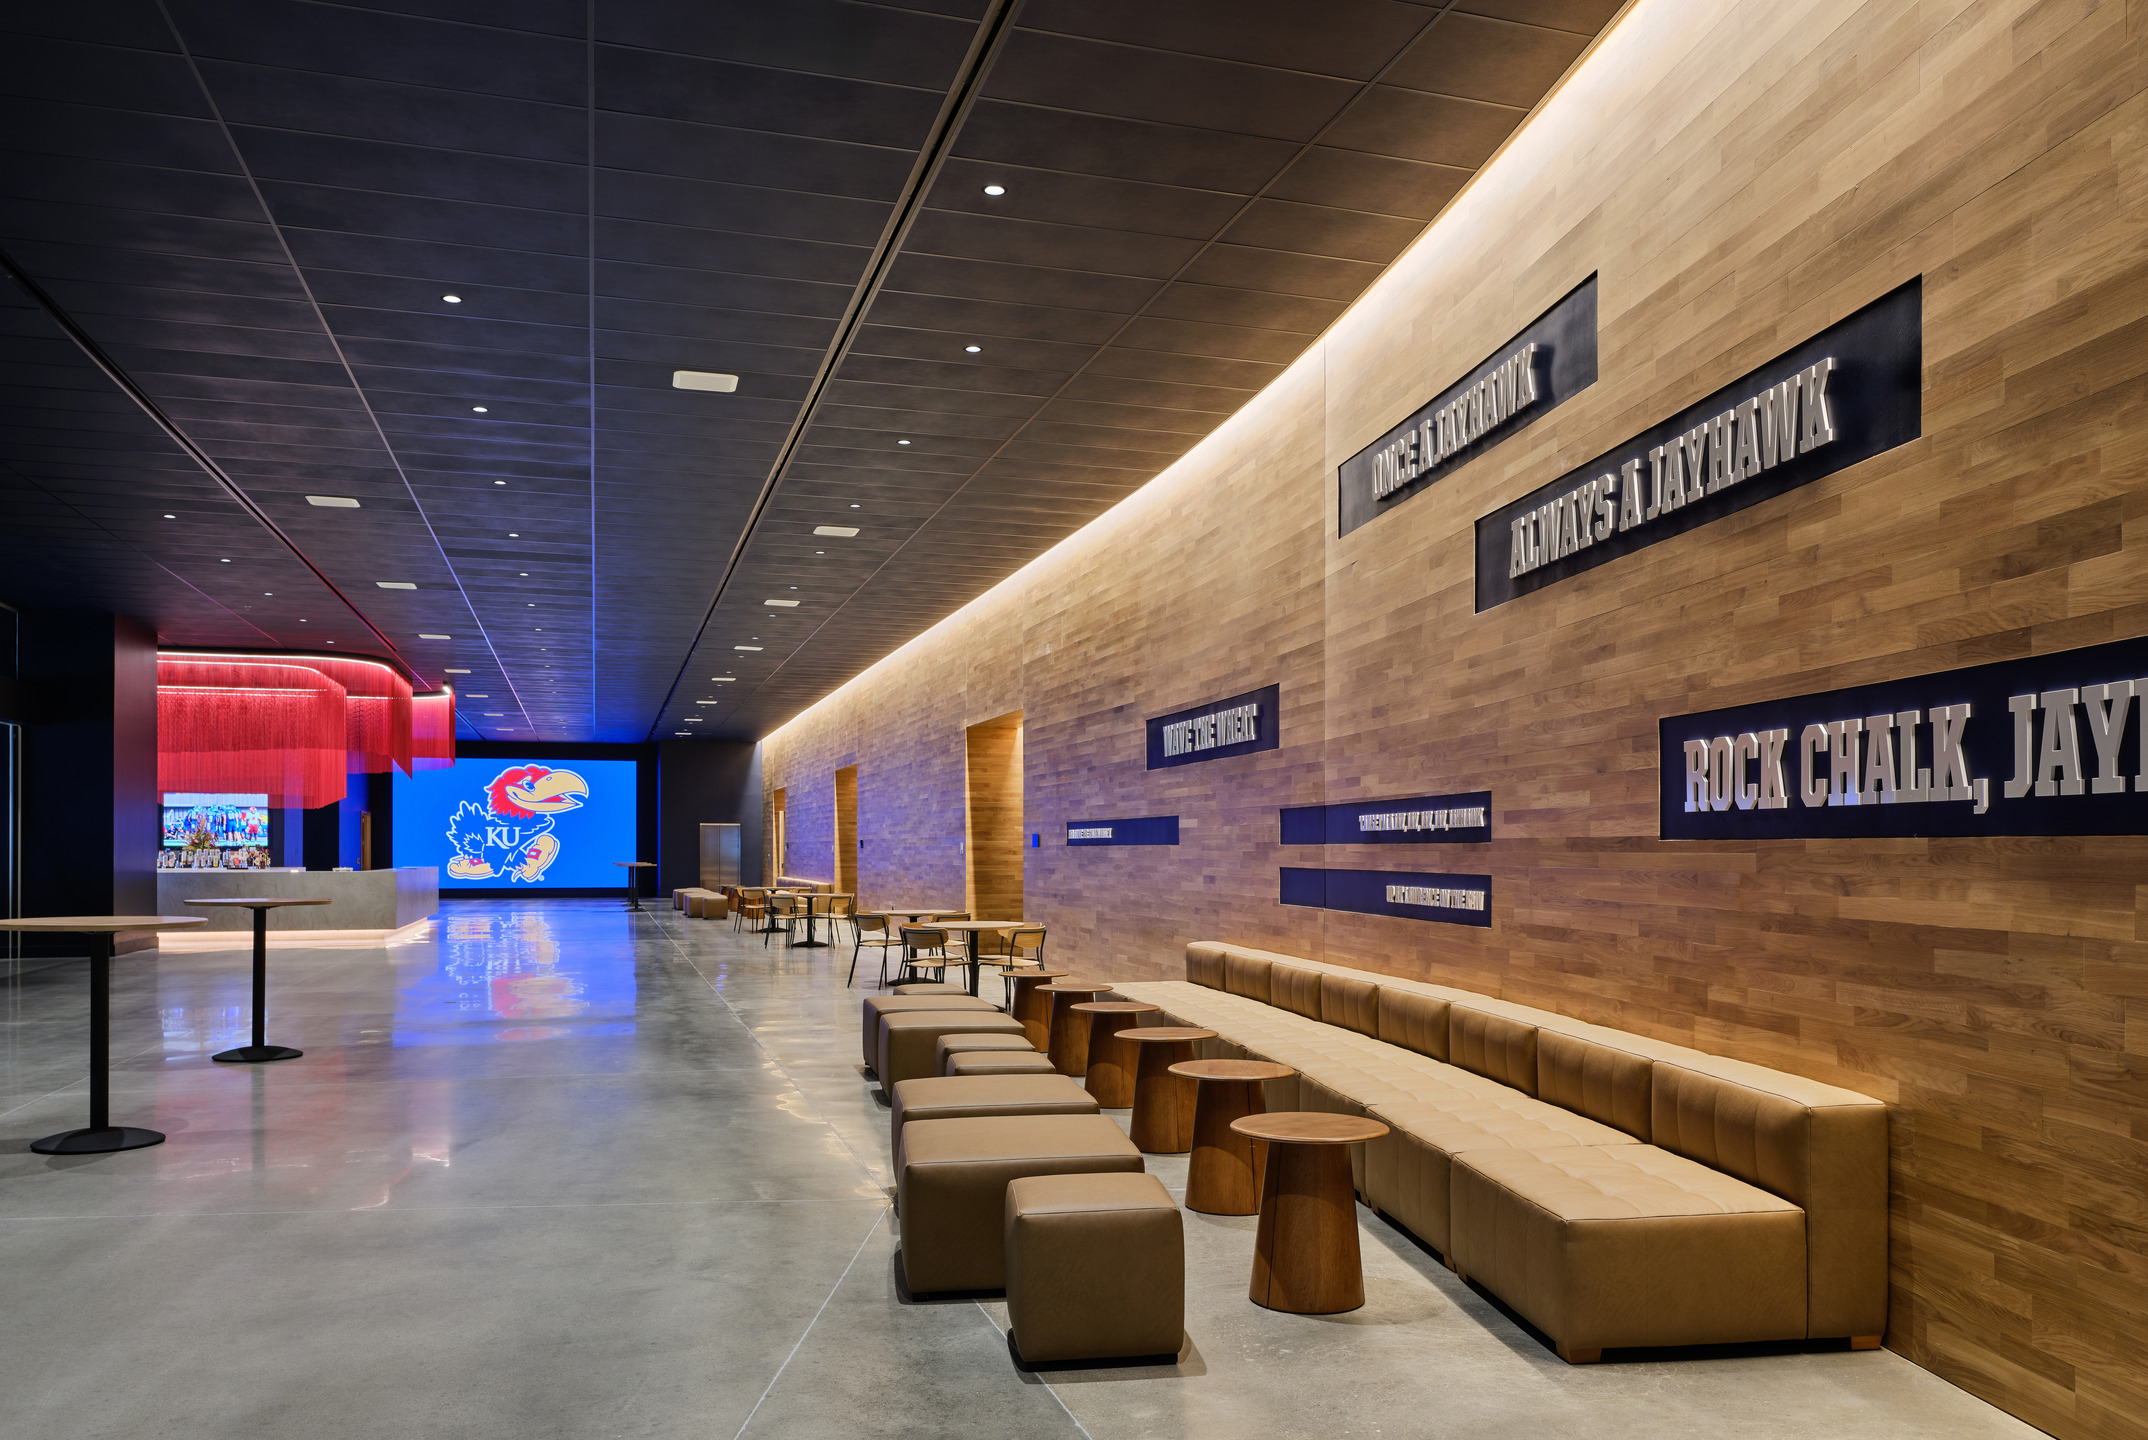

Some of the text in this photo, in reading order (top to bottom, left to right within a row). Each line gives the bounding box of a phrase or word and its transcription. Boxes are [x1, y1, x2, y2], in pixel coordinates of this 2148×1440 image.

[1371, 342, 1538, 501] ONCE A JAYHAWK
[1509, 357, 1834, 579] ALWAYS A JAYHAWK
[1163, 703, 1257, 757] WAVE THE WHEAT
[1683, 728, 1789, 813] ROCK
[1800, 702, 1990, 815] CHALK,
[485, 826, 521, 849] KU
